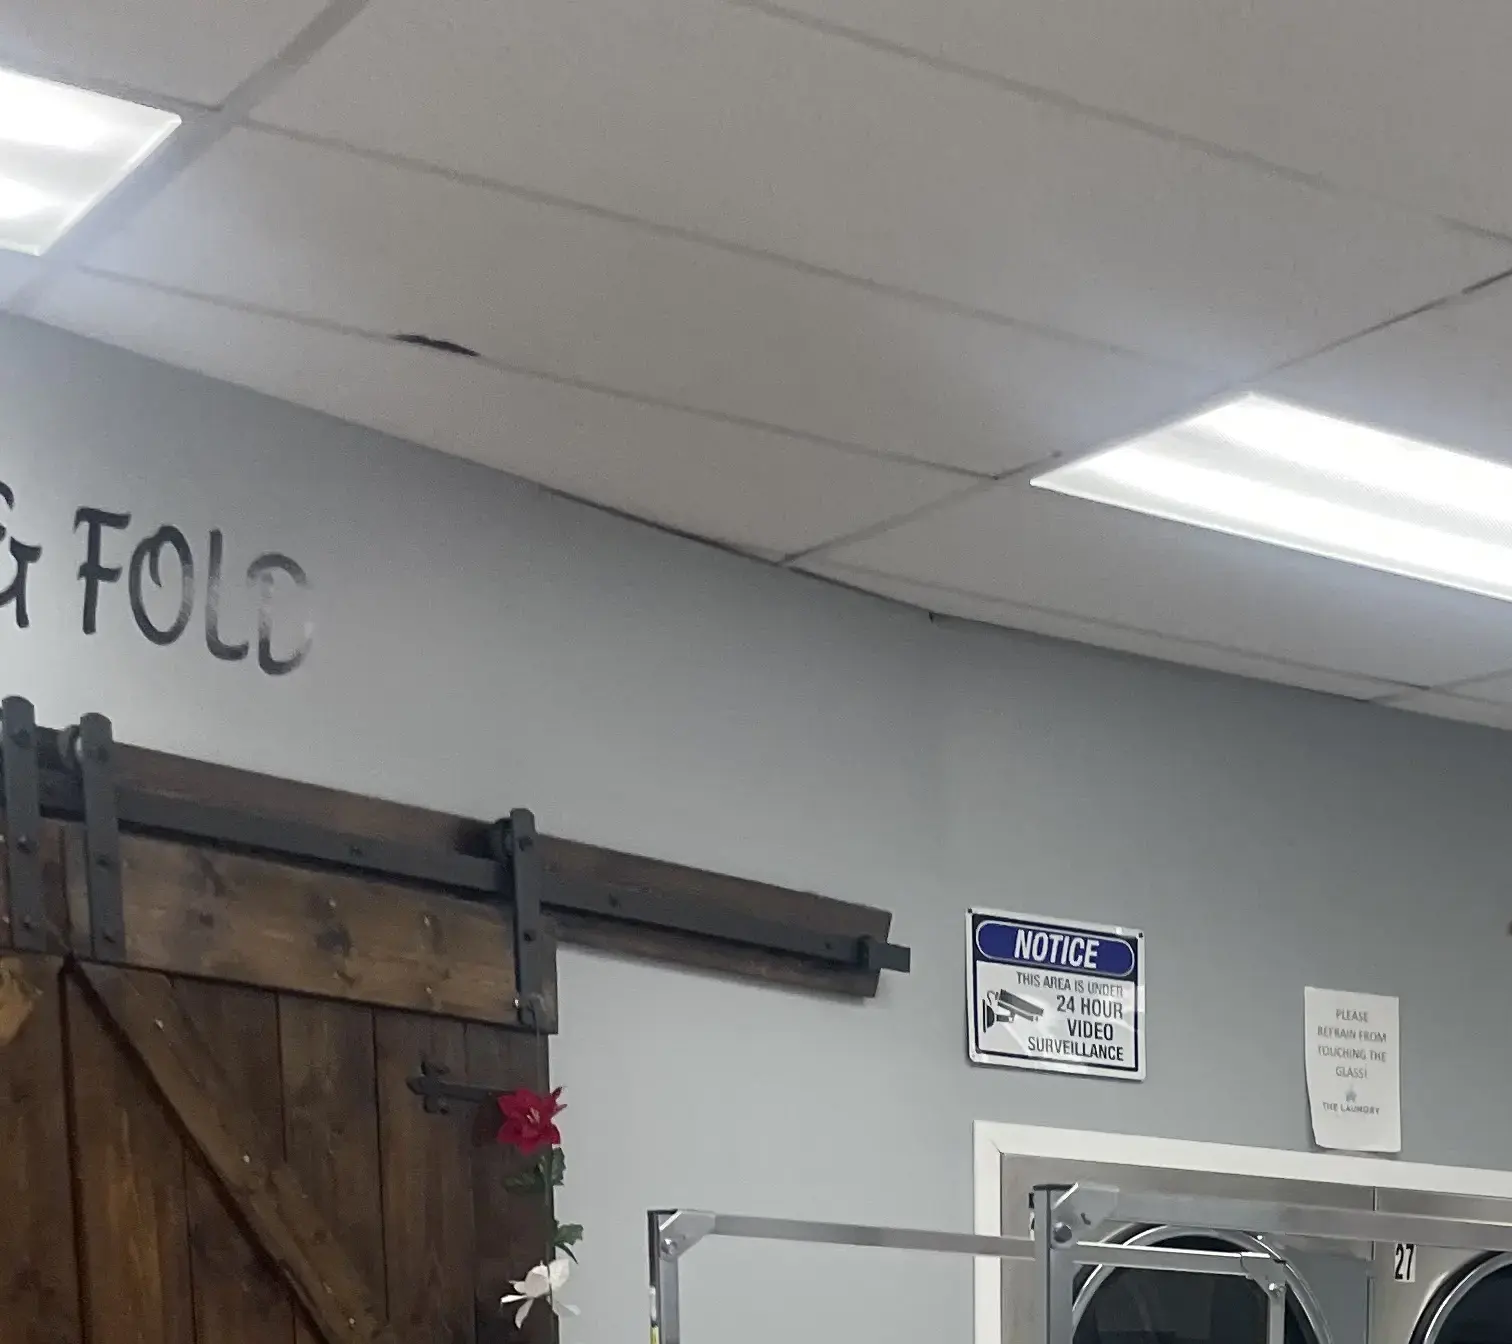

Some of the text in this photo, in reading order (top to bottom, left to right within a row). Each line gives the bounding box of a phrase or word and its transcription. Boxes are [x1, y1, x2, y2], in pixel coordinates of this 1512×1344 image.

[74, 507, 313, 675] FOLD
[1014, 929, 1100, 969] NOTICE
[1016, 971, 1124, 998] THIS AREA IS UNDER
[1056, 995, 1124, 1020] 24 HOUR
[1335, 1008, 1369, 1023] PLEASE
[1066, 1018, 1114, 1041] VIDEO
[1317, 1025, 1387, 1043] REFRAIN FROM
[1027, 1036, 1124, 1062] SURVEILLANCE
[1317, 1045, 1387, 1062] TOUCHING THE
[1322, 1102, 1338, 1112] THE
[1394, 1243, 1414, 1281] 27
